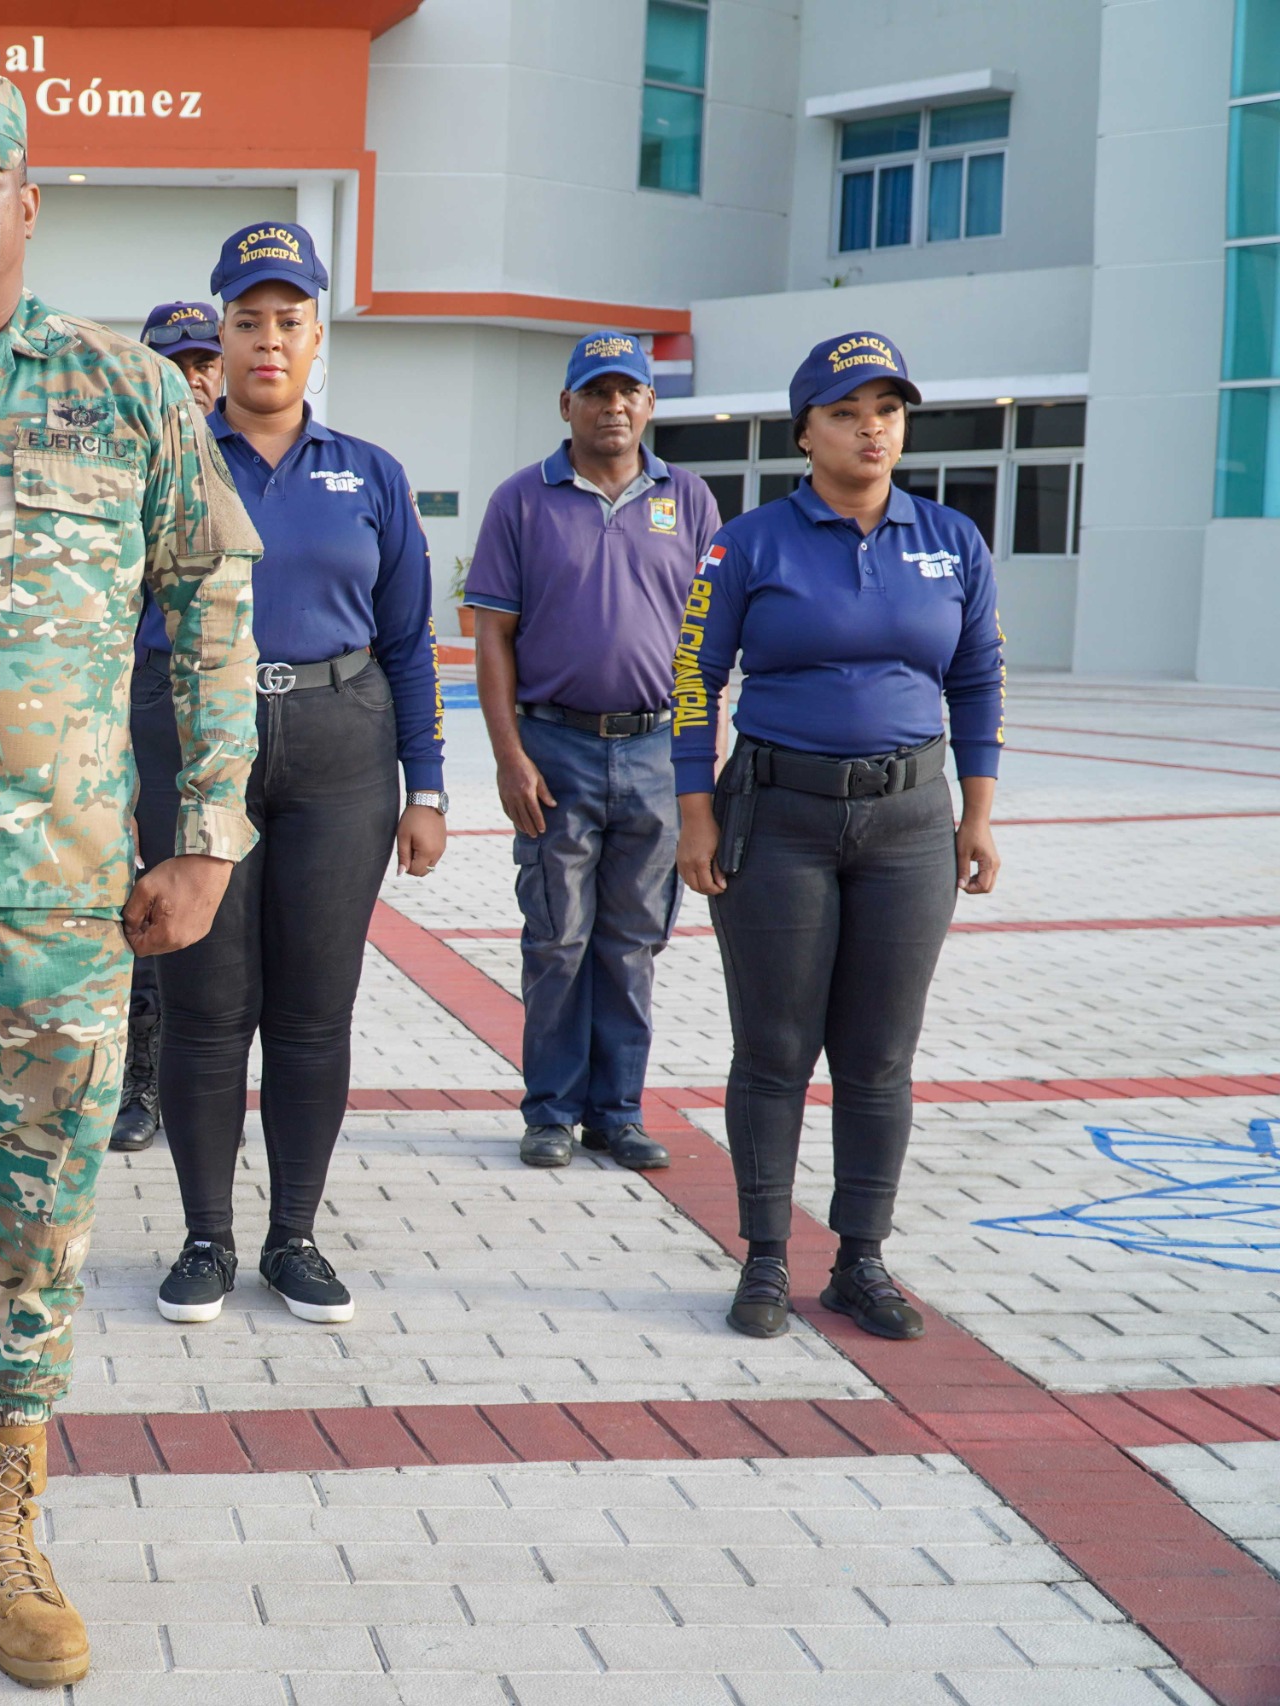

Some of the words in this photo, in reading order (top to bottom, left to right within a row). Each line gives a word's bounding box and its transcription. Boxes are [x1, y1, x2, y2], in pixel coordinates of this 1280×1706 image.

[35, 77, 202, 118] Gómez
[238, 227, 299, 253] POLICIA
[240, 247, 303, 264] MUNICIPAL
[166, 307, 208, 326] POLICI
[585, 338, 634, 350] POLICIA
[585, 345, 634, 357] MUNICIPAL
[828, 336, 893, 363] POLICIA
[832, 354, 898, 373] MUNICIPAL
[28, 431, 129, 458] EJERCITO
[325, 477, 358, 492] SDE
[918, 560, 955, 578] SDE
